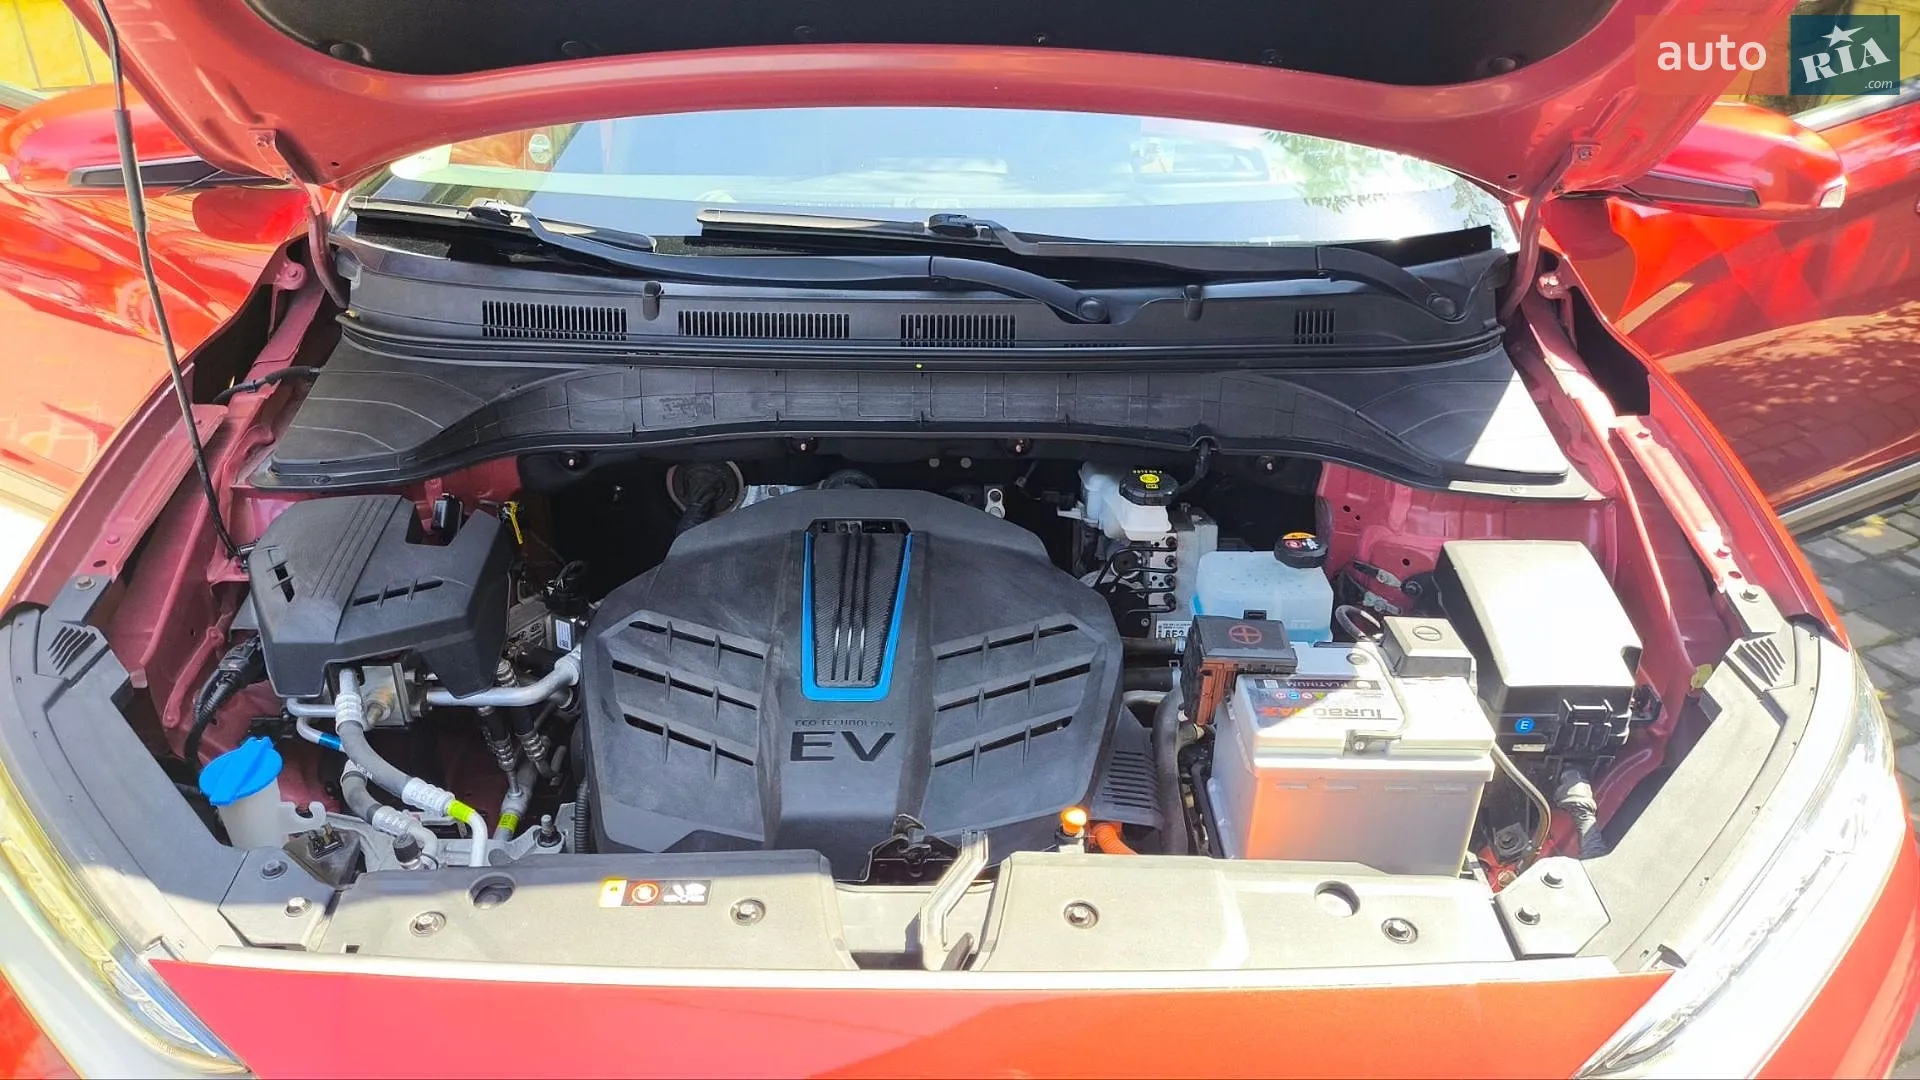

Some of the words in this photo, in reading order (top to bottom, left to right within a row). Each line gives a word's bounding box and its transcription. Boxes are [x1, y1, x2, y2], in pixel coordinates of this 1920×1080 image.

[1286, 680, 1348, 689] PLATINUM
[822, 720, 894, 728] TECHNOLOGY
[1520, 721, 1530, 730] E
[790, 731, 896, 761] EV
